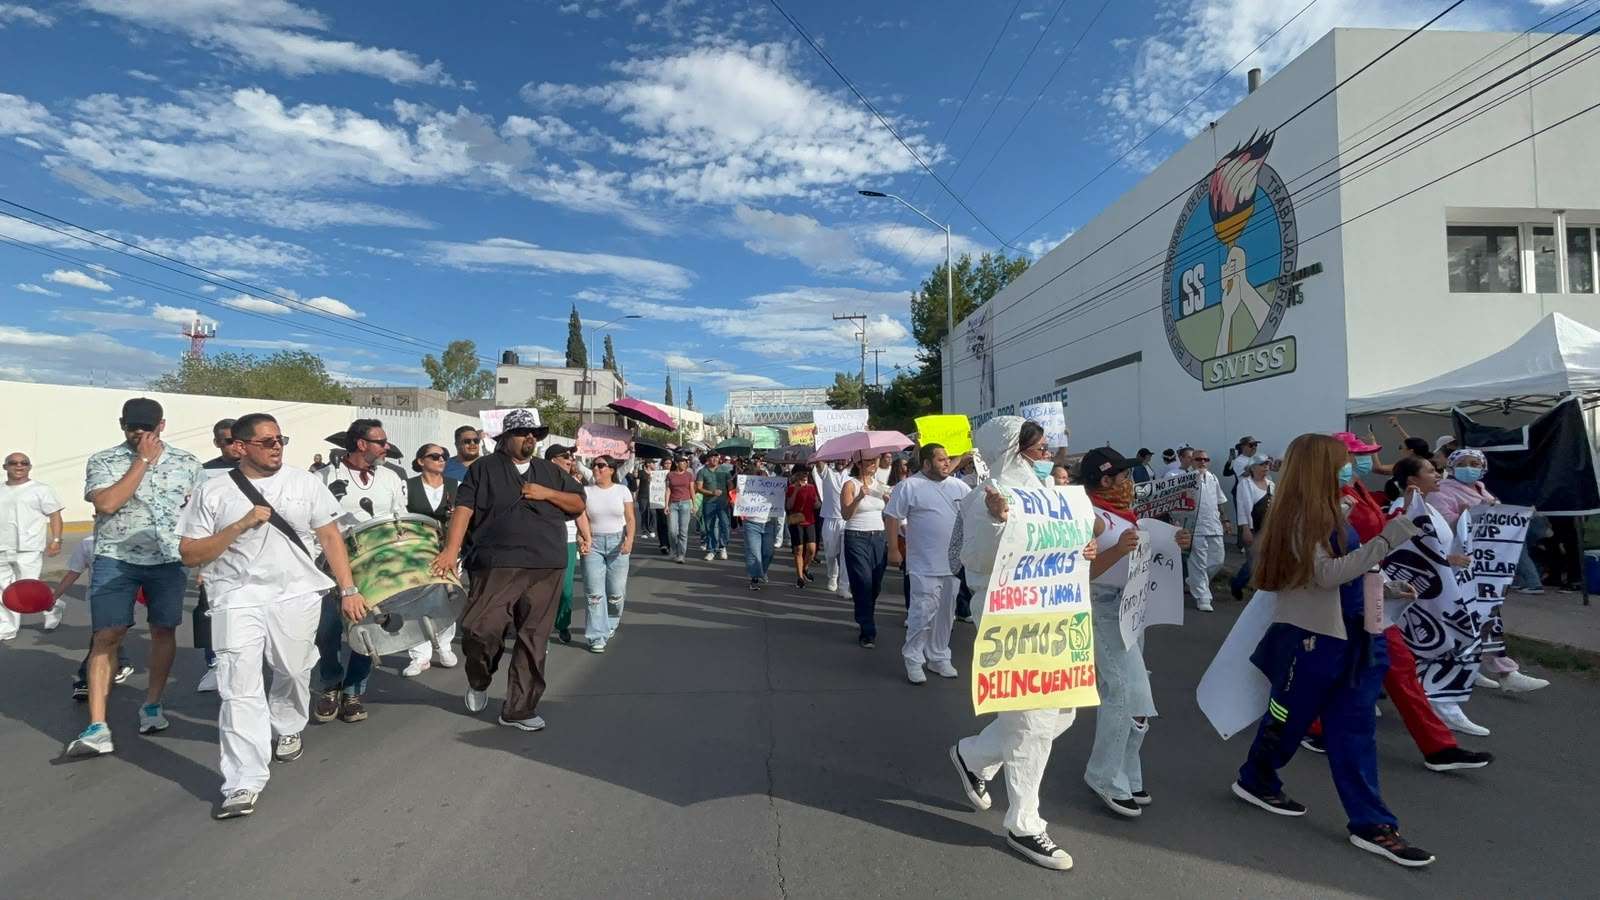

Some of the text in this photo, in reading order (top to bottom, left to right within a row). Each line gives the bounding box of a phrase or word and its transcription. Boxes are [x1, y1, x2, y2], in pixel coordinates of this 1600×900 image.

[1266, 175, 1295, 329] TRABAJADORES
[1182, 263, 1205, 317] SS
[1210, 344, 1287, 384] SNTSS
[1155, 481, 1166, 491] NO
[1168, 478, 1175, 487] TE
[1012, 487, 1073, 521] EN LA
[1026, 519, 1093, 552] PANDEMIA
[989, 583, 1083, 613] HEROES Y AHORA
[979, 618, 1069, 669] SOMOS
[1070, 650, 1091, 664] IMSS
[977, 663, 1096, 707] DELINCUENTES
